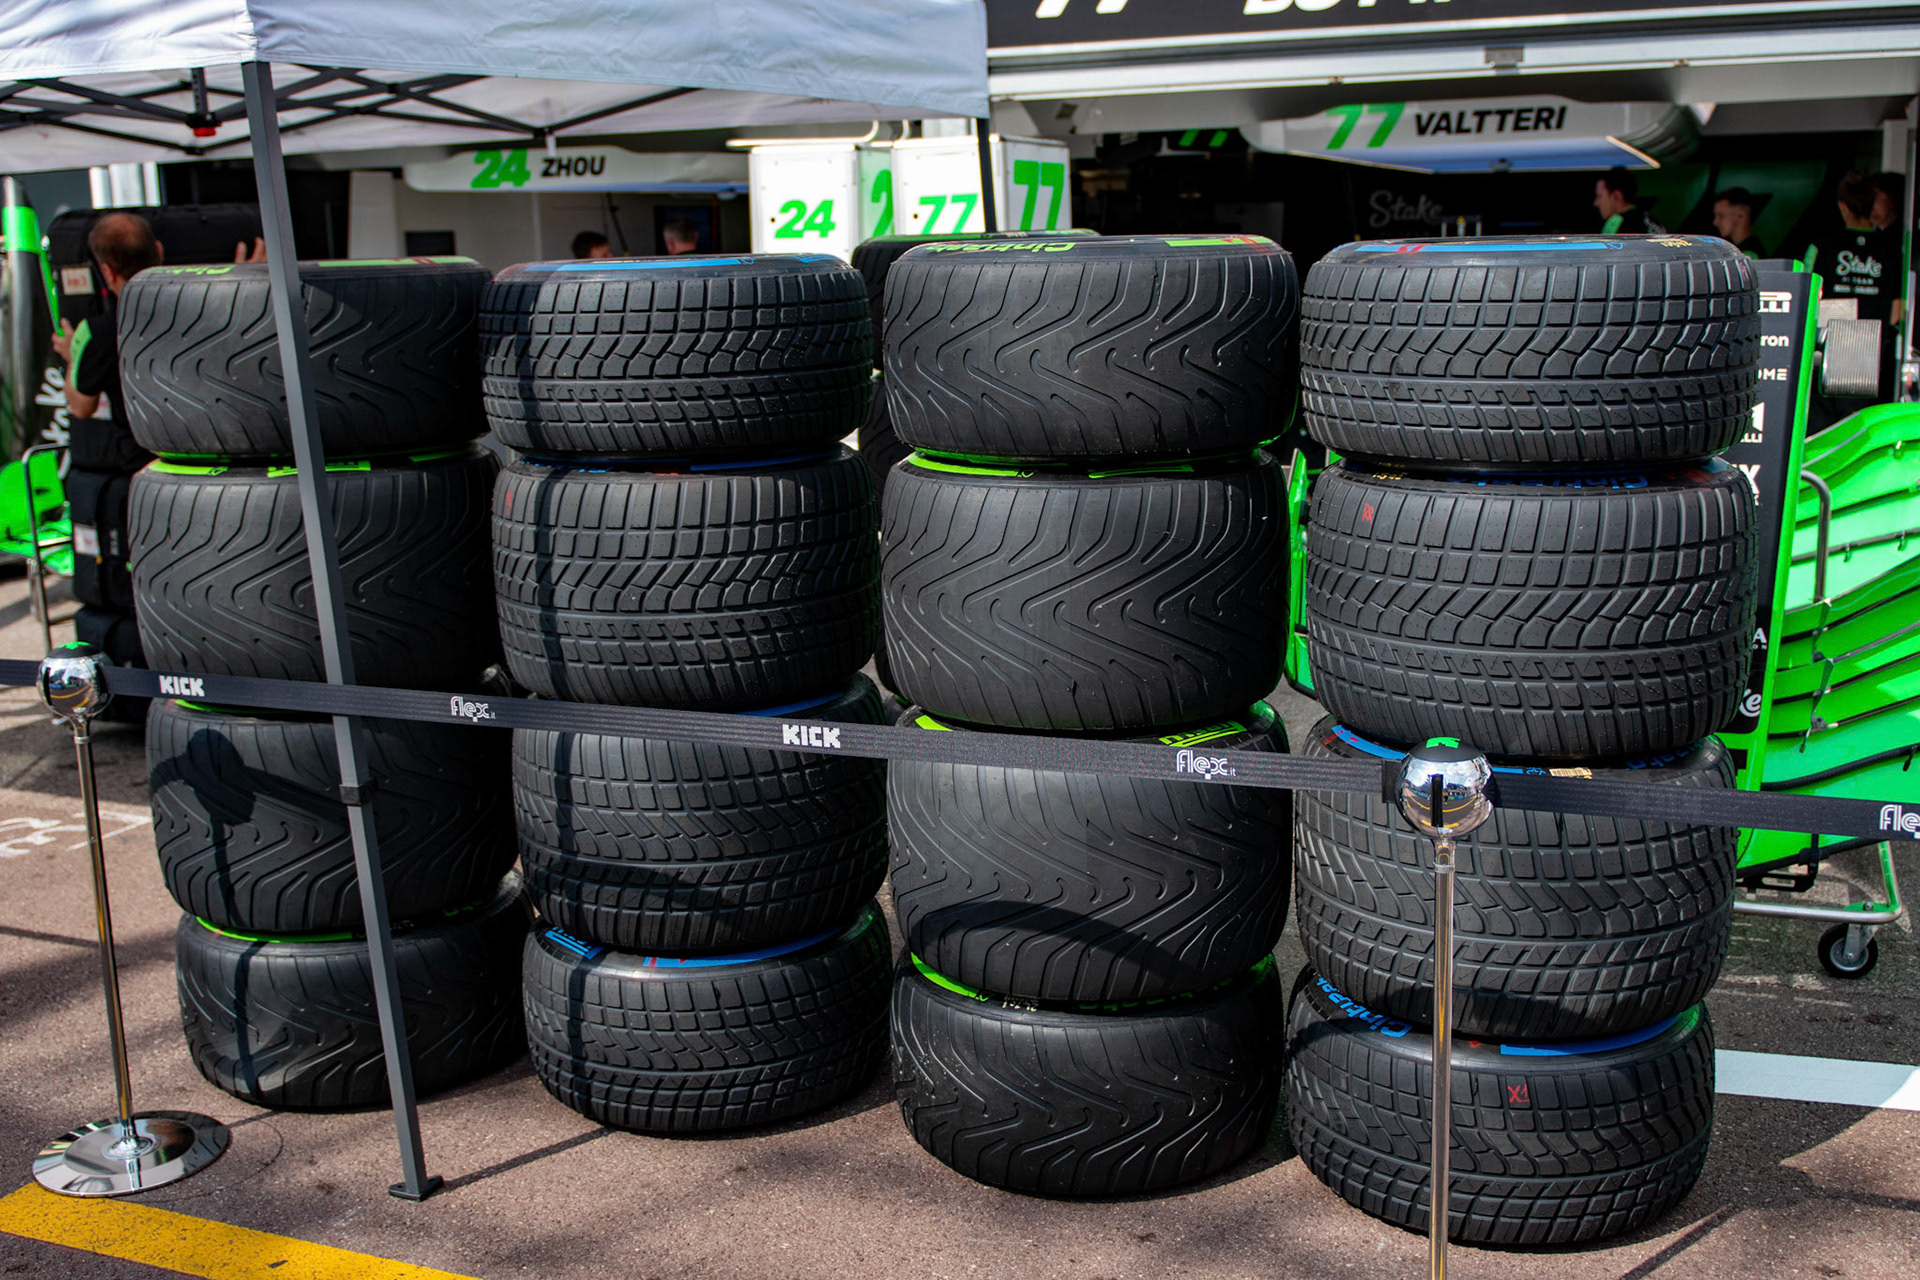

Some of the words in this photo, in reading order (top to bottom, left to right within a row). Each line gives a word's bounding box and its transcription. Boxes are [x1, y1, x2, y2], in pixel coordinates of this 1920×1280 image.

[1326, 102, 1406, 150] 77
[1415, 106, 1567, 136] VALTTERI
[471, 148, 531, 189] 24
[541, 156, 606, 177] ZHOU
[870, 169, 893, 237] 2
[917, 193, 979, 235] 77
[1014, 159, 1065, 231] 77
[1368, 188, 1444, 229] Stake
[774, 199, 836, 239] 24
[1835, 250, 1883, 278] Stake
[1760, 335, 1790, 347] ron
[159, 675, 205, 697] KICK
[782, 724, 841, 749] KICK
[1880, 804, 1920, 838] fle
[1316, 973, 1413, 1038] Cinturat
